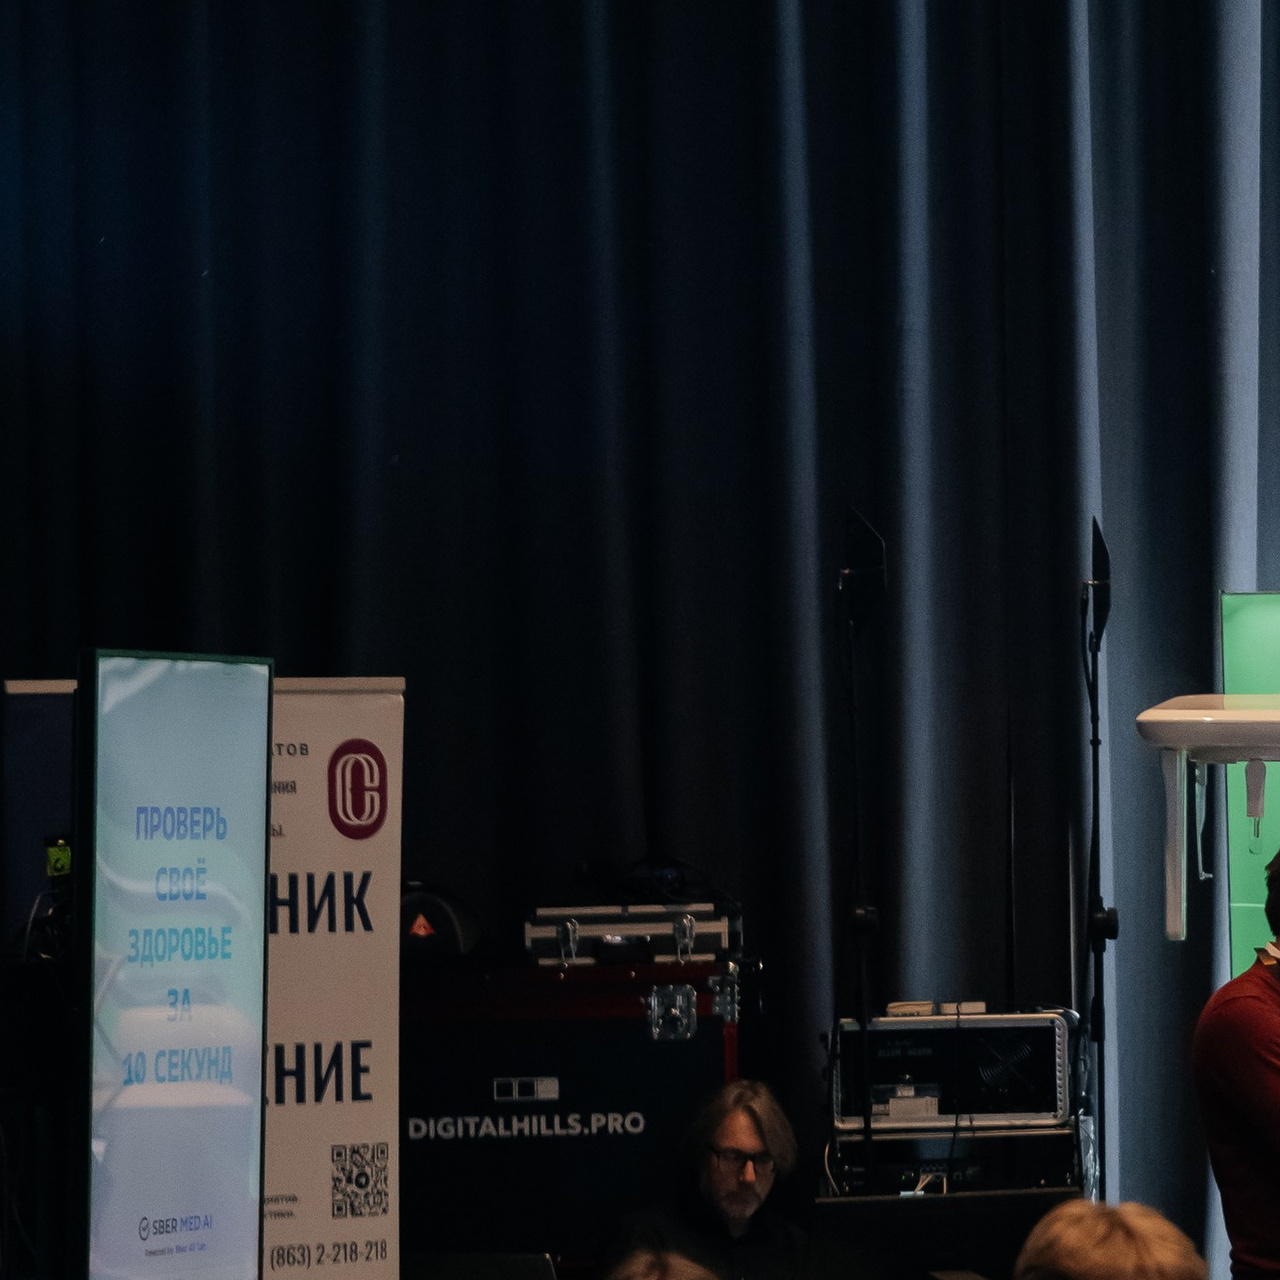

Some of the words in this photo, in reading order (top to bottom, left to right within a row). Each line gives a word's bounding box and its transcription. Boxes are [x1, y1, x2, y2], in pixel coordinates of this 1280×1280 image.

[136, 805, 228, 840] ПРОВЕРЬ
[155, 857, 208, 901] СВОЁ
[269, 870, 374, 934] НИК
[126, 926, 233, 968] ЗДОРОВЬЕ
[167, 988, 193, 1022] ЗА
[122, 1051, 147, 1087] 10
[154, 1046, 233, 1085] СЕКУНД
[266, 1040, 373, 1105] НИЕ
[408, 1111, 646, 1140] DIGITALHILLS.PRO
[152, 1217, 178, 1235] SBER
[270, 1243, 311, 1271] (863)
[316, 1239, 388, 1265] 2-218-218
